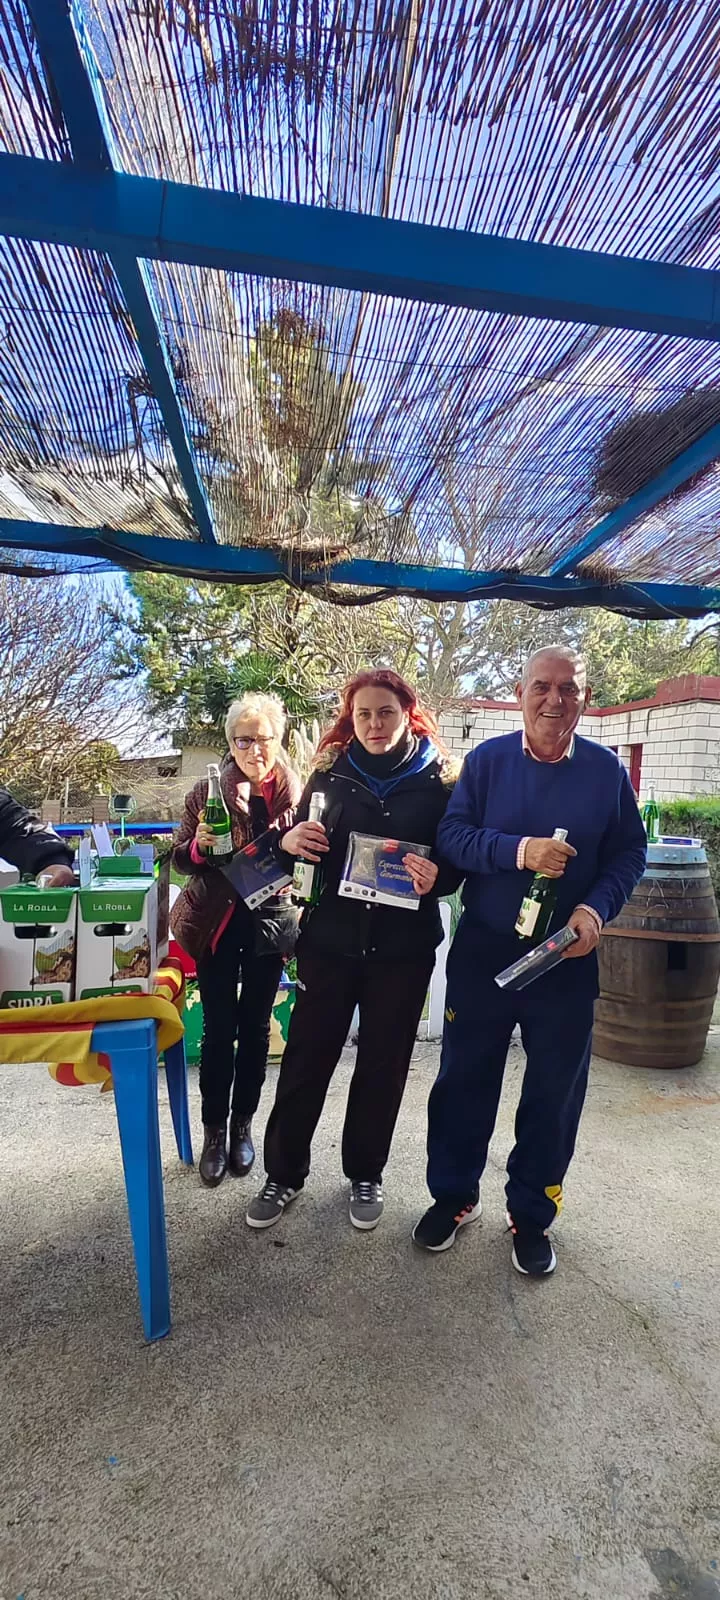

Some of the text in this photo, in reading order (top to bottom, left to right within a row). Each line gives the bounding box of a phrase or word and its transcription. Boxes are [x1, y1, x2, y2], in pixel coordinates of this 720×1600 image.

[13, 903, 57, 911] LA ROBLA
[93, 903, 132, 911] LA ROBLA
